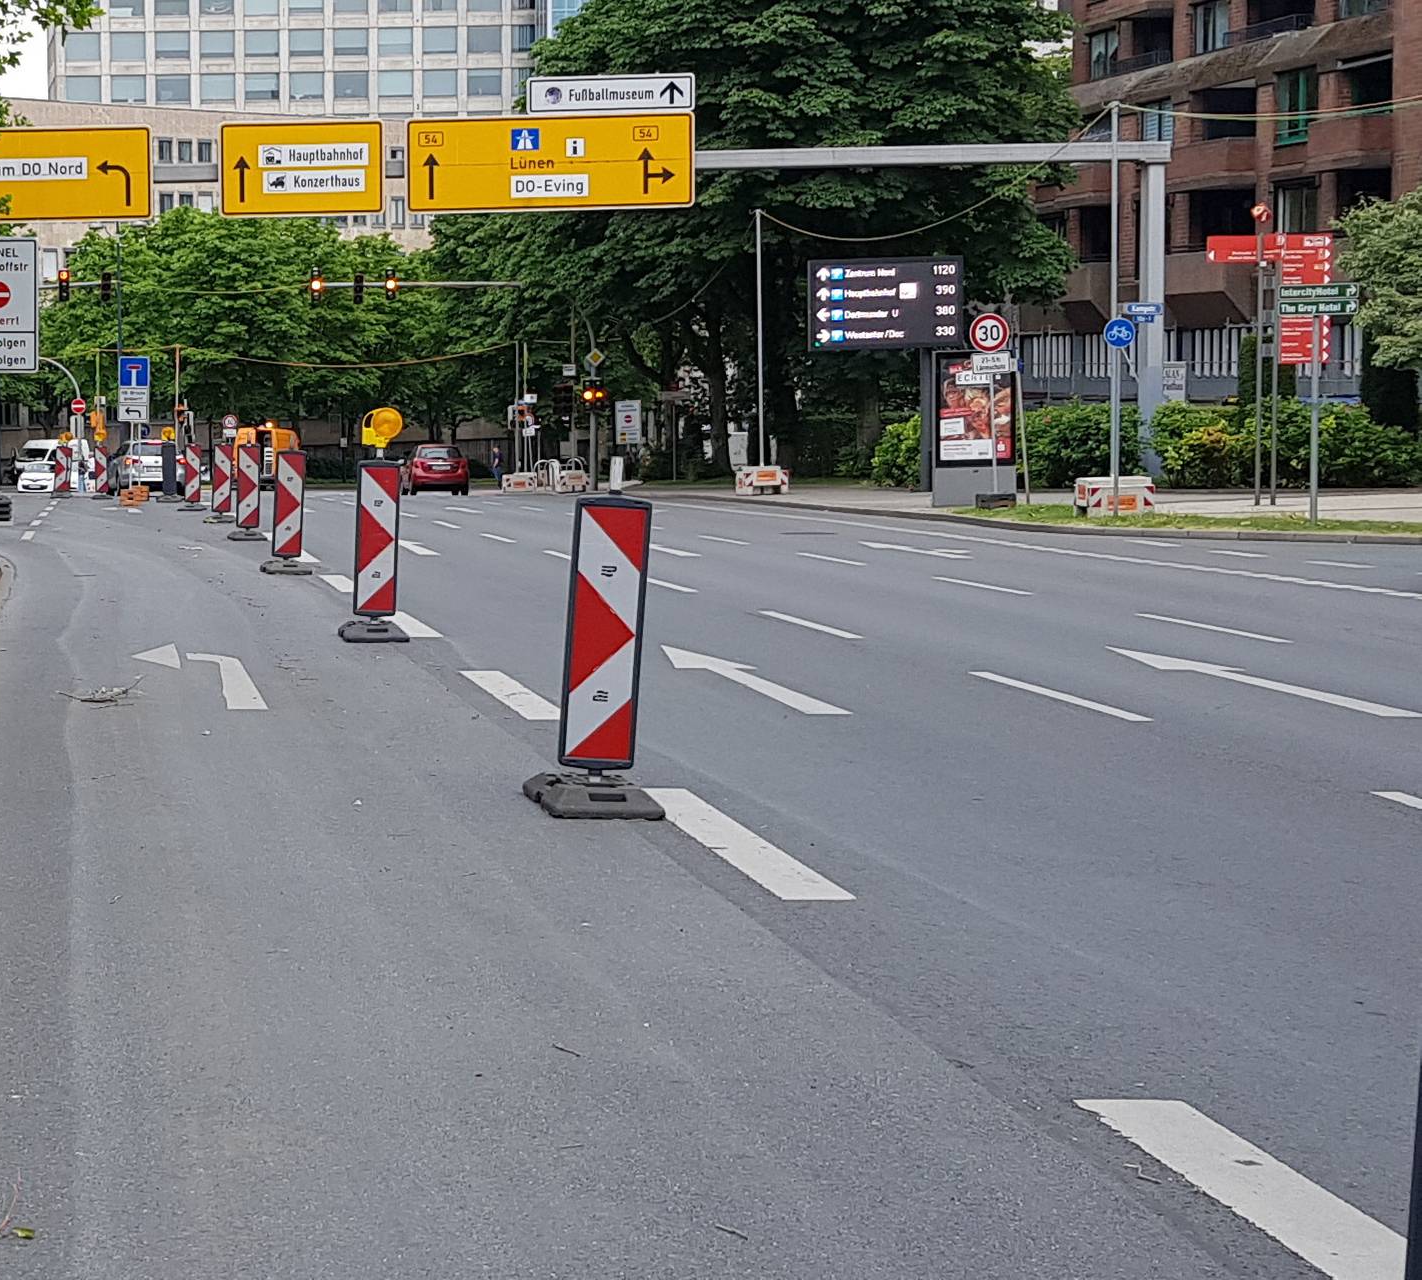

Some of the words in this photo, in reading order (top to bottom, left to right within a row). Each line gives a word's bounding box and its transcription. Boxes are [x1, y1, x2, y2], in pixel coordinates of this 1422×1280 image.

[568, 87, 655, 102] Fußballmuseum
[424, 134, 438, 145] 54
[639, 128, 653, 139] 54
[288, 147, 364, 164] Hauptbahnhof
[21, 162, 42, 176] DO
[48, 161, 83, 176] Nord
[510, 157, 555, 170] Lünen
[293, 174, 361, 188] Konzerthaus
[515, 179, 585, 195] DO-Eving
[932, 264, 956, 276] 1120
[935, 284, 956, 296] 390
[935, 304, 956, 316] 380
[1281, 303, 1296, 313] The
[1298, 303, 1317, 314] Grey
[1318, 302, 1341, 312] Hotel
[935, 325, 956, 337] 330
[978, 325, 1000, 341] 30
